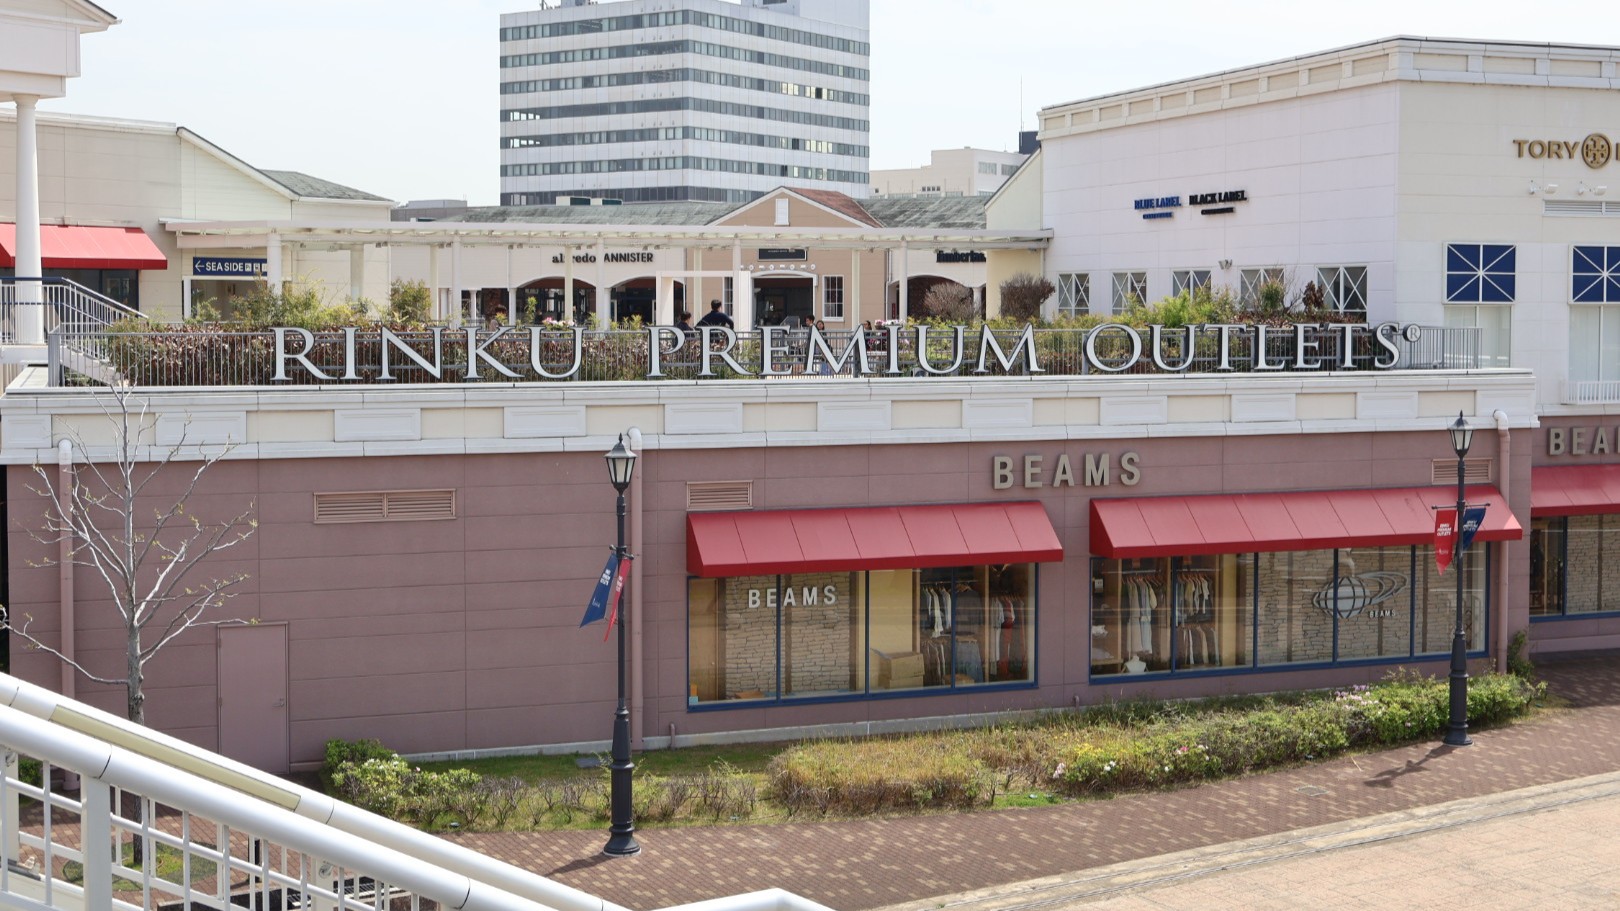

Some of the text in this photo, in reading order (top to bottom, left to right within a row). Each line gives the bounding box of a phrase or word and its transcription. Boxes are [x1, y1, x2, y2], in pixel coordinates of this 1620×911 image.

[1512, 139, 1580, 159] TORY
[1134, 196, 1181, 210] BLUE LABEL
[1189, 190, 1247, 205] BLACK LABEL
[552, 252, 654, 263] alredo ANNISTER
[205, 261, 223, 272] SEA
[224, 261, 244, 272] SIDE
[269, 325, 588, 381] RINKU
[646, 322, 1046, 377] PREMIUM
[993, 452, 1141, 490] BEAMS
[748, 585, 836, 609] BEAMS
[1369, 609, 1396, 618] BEAMS
